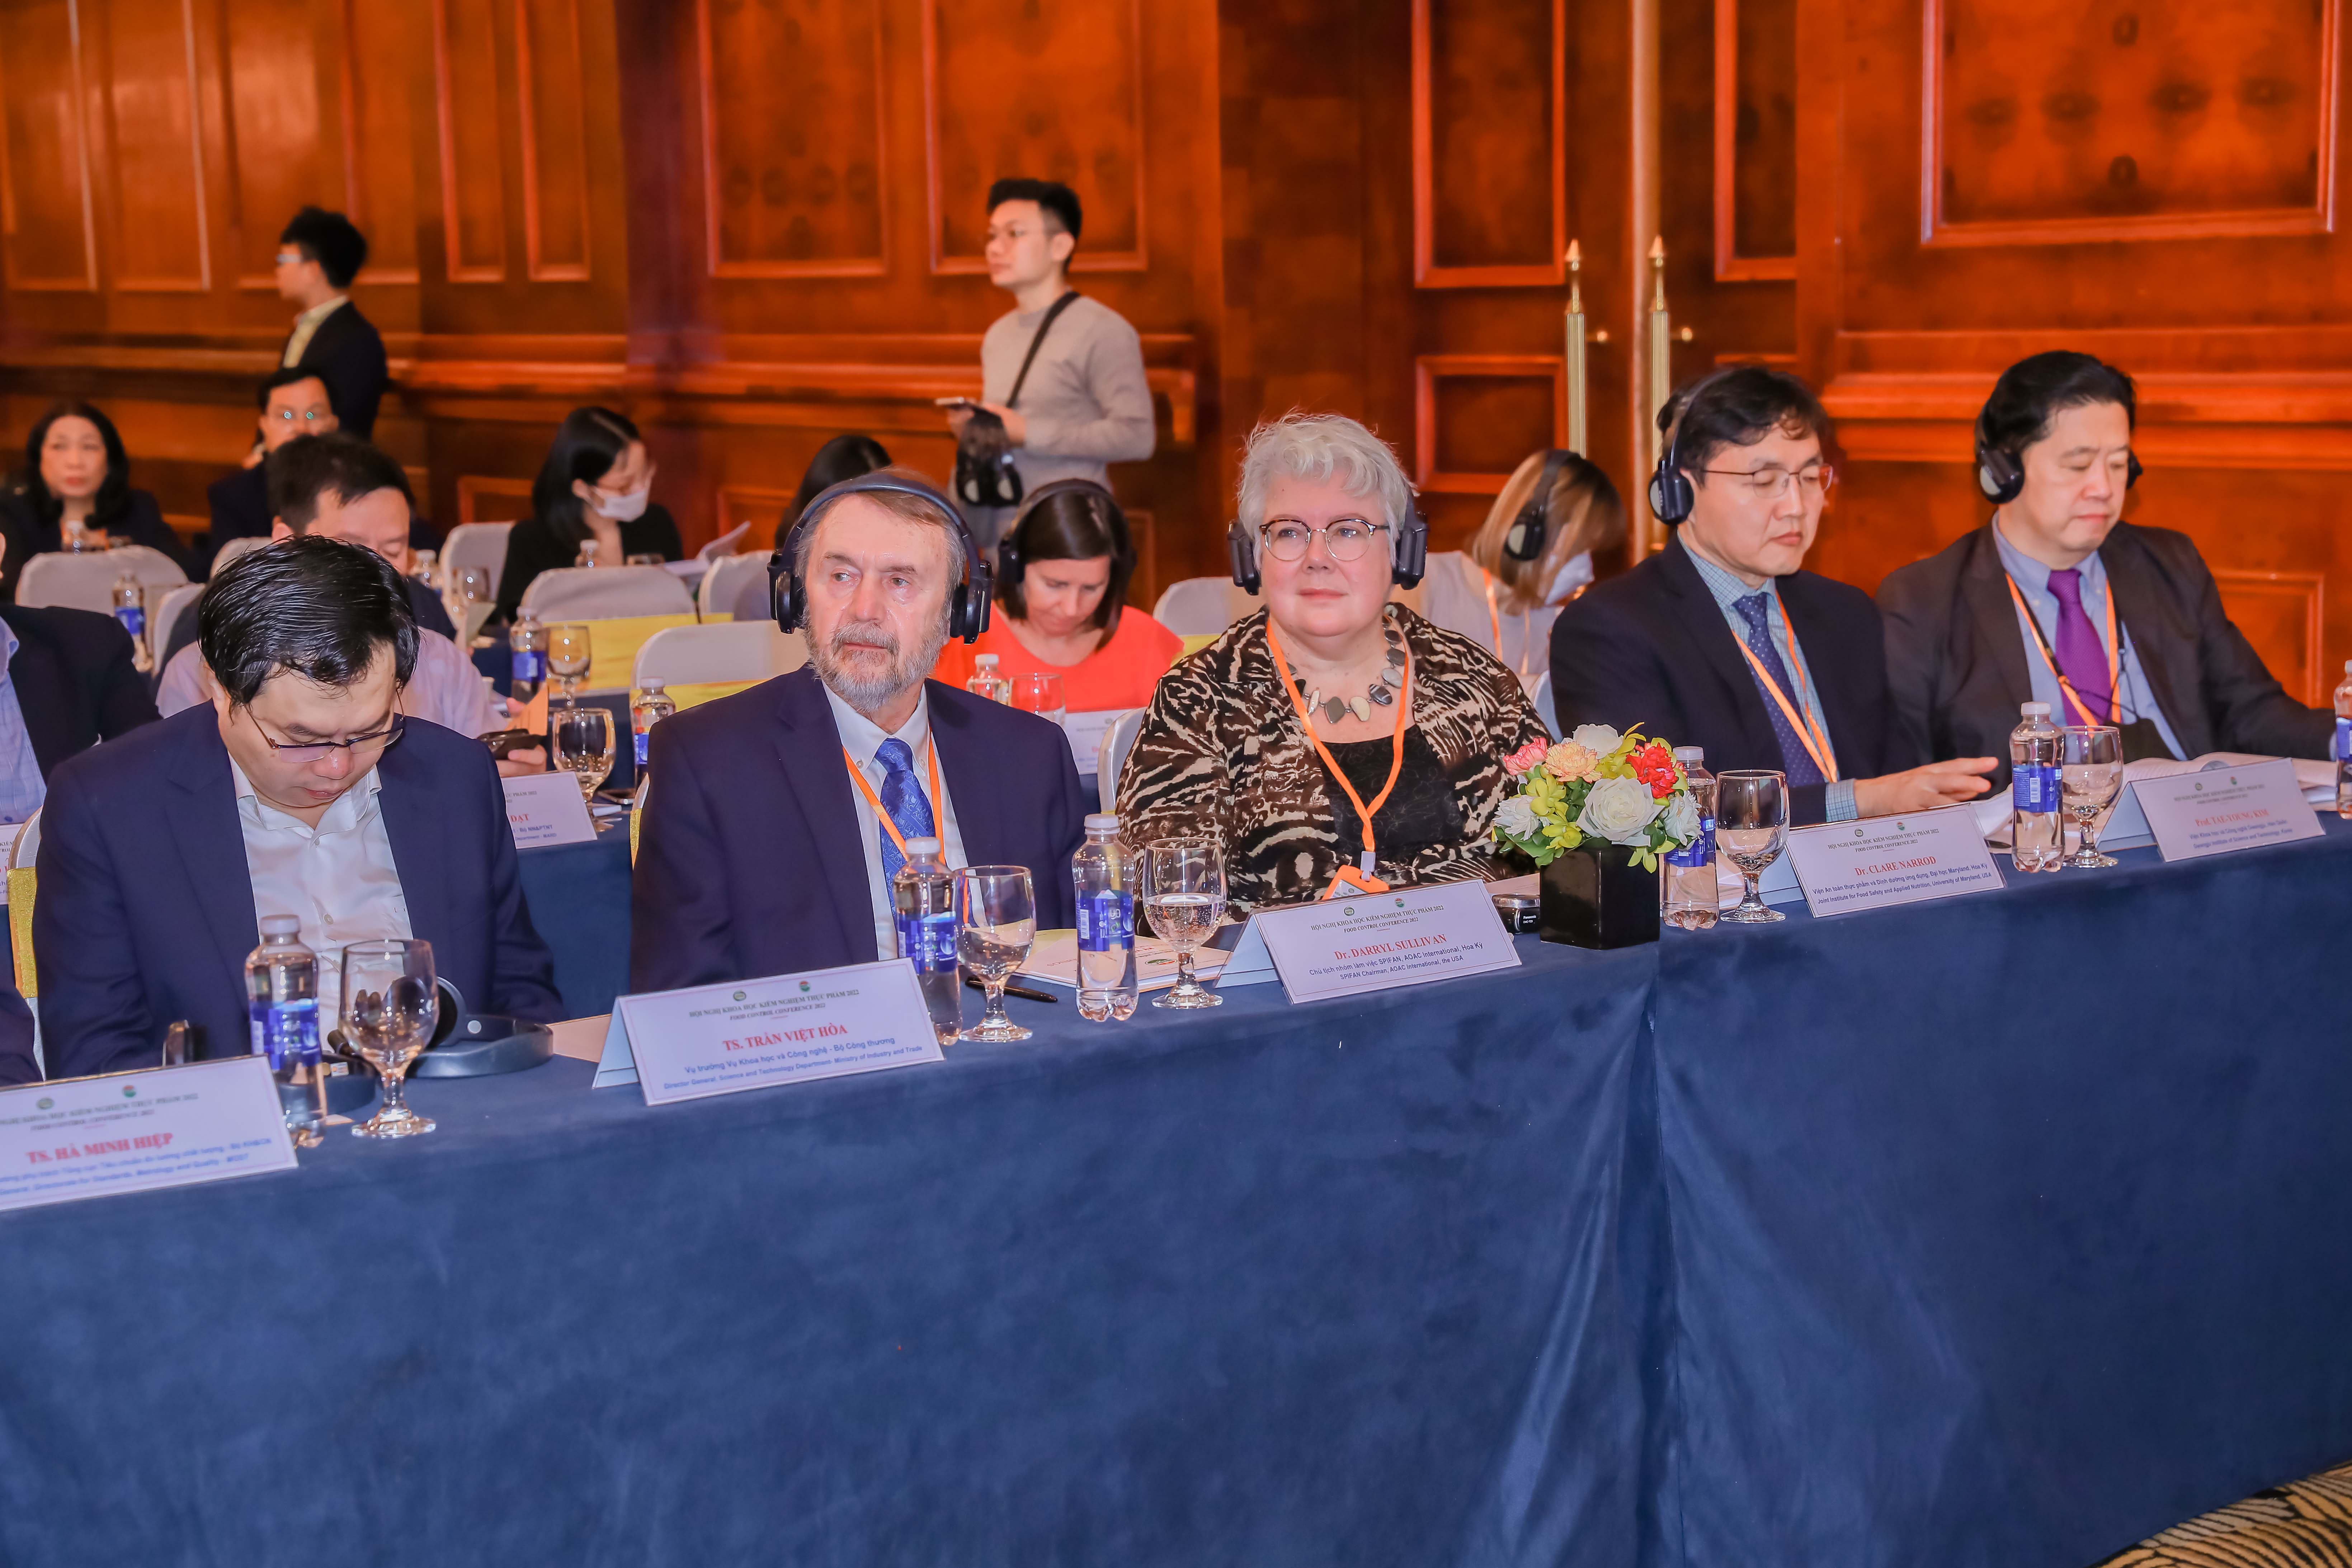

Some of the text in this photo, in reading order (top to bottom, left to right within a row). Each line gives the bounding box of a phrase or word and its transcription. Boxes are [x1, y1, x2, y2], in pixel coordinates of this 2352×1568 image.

[1868, 862, 1899, 874] CLARE
[1898, 856, 1936, 869] NARROD
[1856, 880, 1870, 889] phẩm
[1893, 885, 1912, 893] Applied
[1379, 918, 1409, 927] CONFERENCE
[1334, 934, 1447, 960] Dr. DARRYL SULLIVAN
[1378, 956, 1404, 965] SPIFAN,
[1404, 952, 1422, 961] AOAC
[1421, 946, 1462, 958] International,
[1340, 971, 1361, 980] SPIFAN
[1405, 959, 1441, 969] International,
[722, 1039, 744, 1051] TS.
[784, 1028, 815, 1042] VIỆT
[818, 1022, 848, 1037] HÒA
[26, 1150, 53, 1164] TS.
[55, 1144, 81, 1160] HÀ
[84, 1139, 131, 1155] MINH
[133, 1132, 174, 1149] HIỆP
